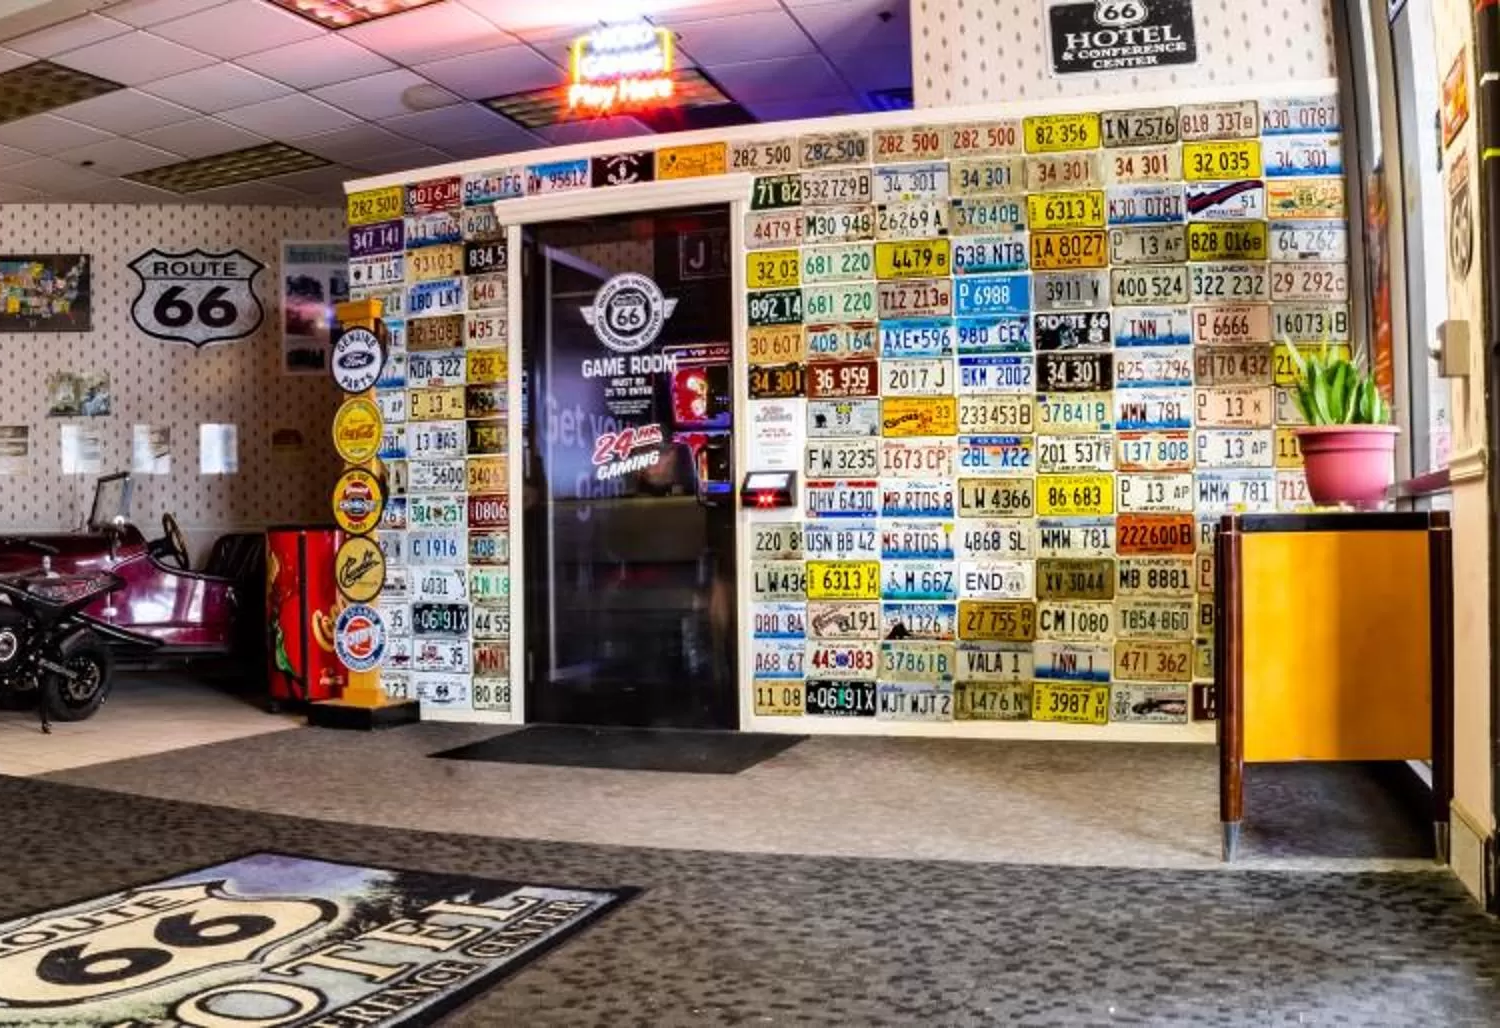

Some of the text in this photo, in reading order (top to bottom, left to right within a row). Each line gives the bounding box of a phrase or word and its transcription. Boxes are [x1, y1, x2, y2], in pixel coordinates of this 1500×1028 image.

[1104, 3, 1137, 20] 66
[1064, 25, 1181, 50] HOTEL
[1078, 42, 1186, 58] CONFERENCE
[1092, 55, 1159, 69] CENTER
[1105, 117, 1174, 138] IN 2576
[879, 134, 938, 152] 282 500
[954, 128, 1014, 148] 282 500
[733, 150, 757, 166] 282
[766, 146, 791, 163] 500
[805, 140, 864, 160] 282 500
[1116, 156, 1168, 175] 34 301
[1194, 151, 1249, 171] 32 035
[961, 167, 1011, 187] 34 301
[1038, 161, 1090, 182] 34 301
[884, 174, 936, 193] 34 301
[351, 199, 372, 218] 282
[1046, 201, 1084, 220] 6313
[842, 213, 870, 232] 948
[353, 230, 374, 249] 347
[1060, 235, 1102, 254] 8027
[805, 253, 870, 274] 681 220
[955, 245, 986, 267] 638
[153, 261, 237, 277] ROUTE
[1117, 277, 1182, 297] 400 524
[1194, 276, 1263, 294] 322 232
[807, 293, 871, 314] 681 220
[974, 286, 1010, 305] 6988
[153, 285, 238, 328] 66
[751, 300, 777, 319] 892
[617, 308, 640, 326] 66
[1214, 315, 1249, 334] 6666
[751, 336, 800, 355] 30 607
[582, 353, 677, 378] GAME ROOM
[1048, 355, 1100, 375] 34 301
[816, 367, 869, 389] 36 959
[997, 367, 1030, 386] 2002
[1158, 402, 1182, 420] 781
[592, 428, 637, 465] 24
[1041, 443, 1101, 463] 201 537
[1157, 442, 1188, 460] 808
[597, 450, 660, 481] GAMING
[883, 450, 945, 470] 1673 CP
[433, 467, 463, 485] 5600
[992, 492, 1030, 510] 4366
[1240, 481, 1268, 502] 781
[427, 538, 457, 556] 1916
[965, 531, 1026, 552] 4868 SL
[1083, 529, 1110, 549] 781
[824, 570, 861, 590] 6313
[966, 573, 1002, 591] END
[1120, 652, 1147, 673] 471
[1158, 653, 1187, 673] 362
[1050, 693, 1089, 714] 3987
[35, 907, 276, 986] 66
[155, 893, 547, 1028] OTEL
